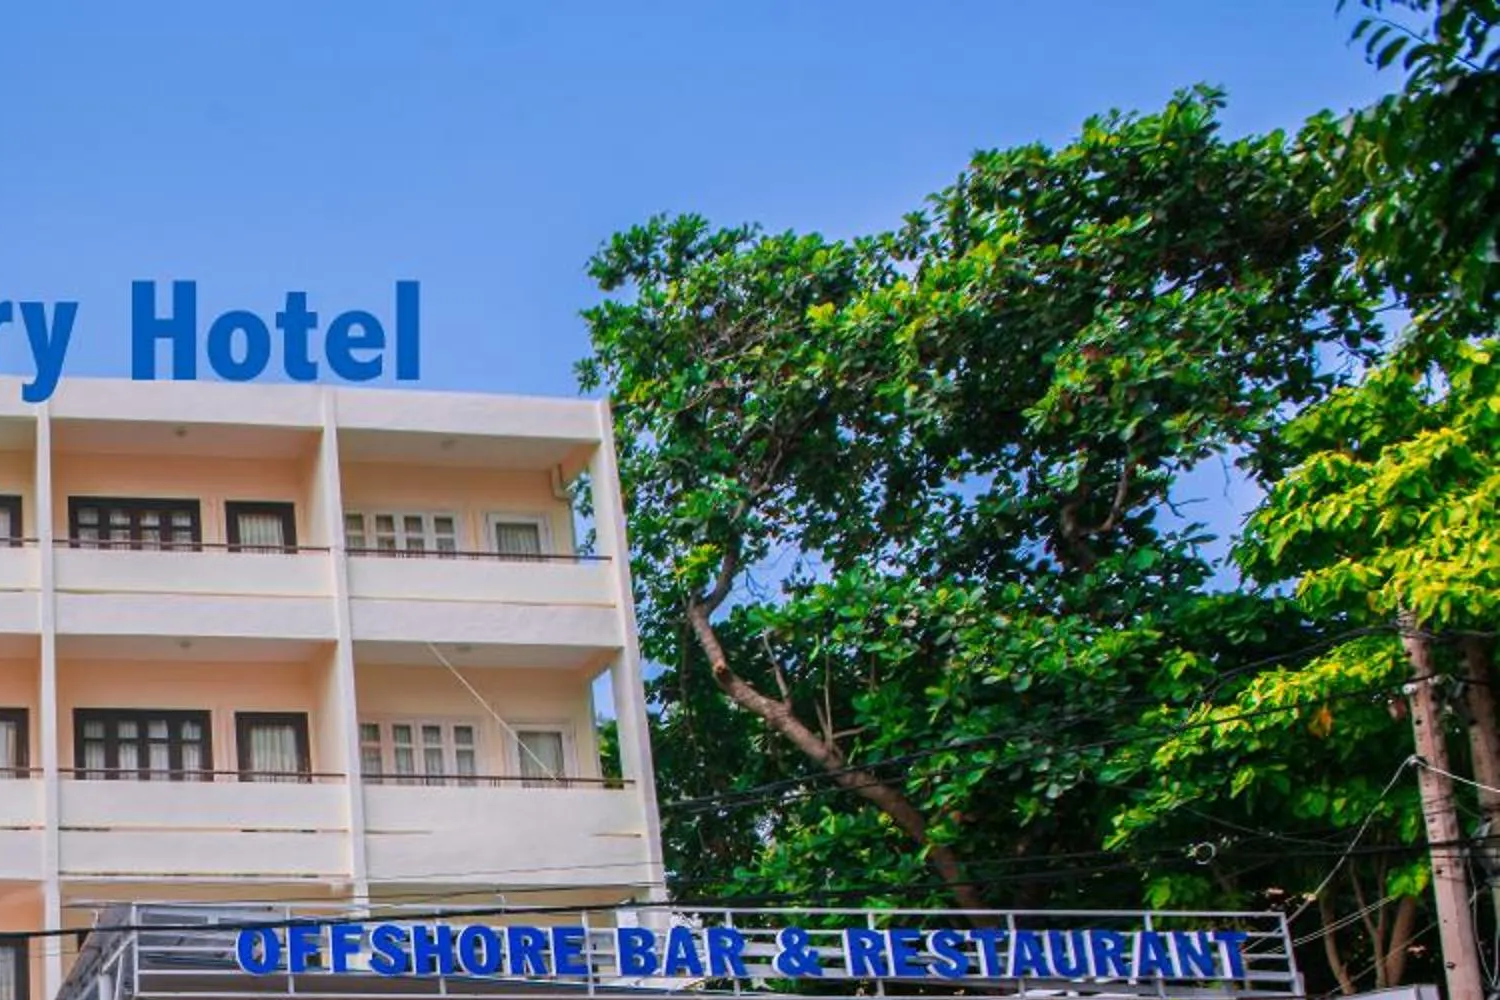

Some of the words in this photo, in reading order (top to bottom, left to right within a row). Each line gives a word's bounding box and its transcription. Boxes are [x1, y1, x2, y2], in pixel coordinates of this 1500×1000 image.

[132, 281, 420, 381] Hotel
[236, 922, 591, 976] OFFSHORE
[616, 926, 748, 977] BAR
[773, 926, 825, 977] &
[843, 927, 1249, 979] RESTAURANT
